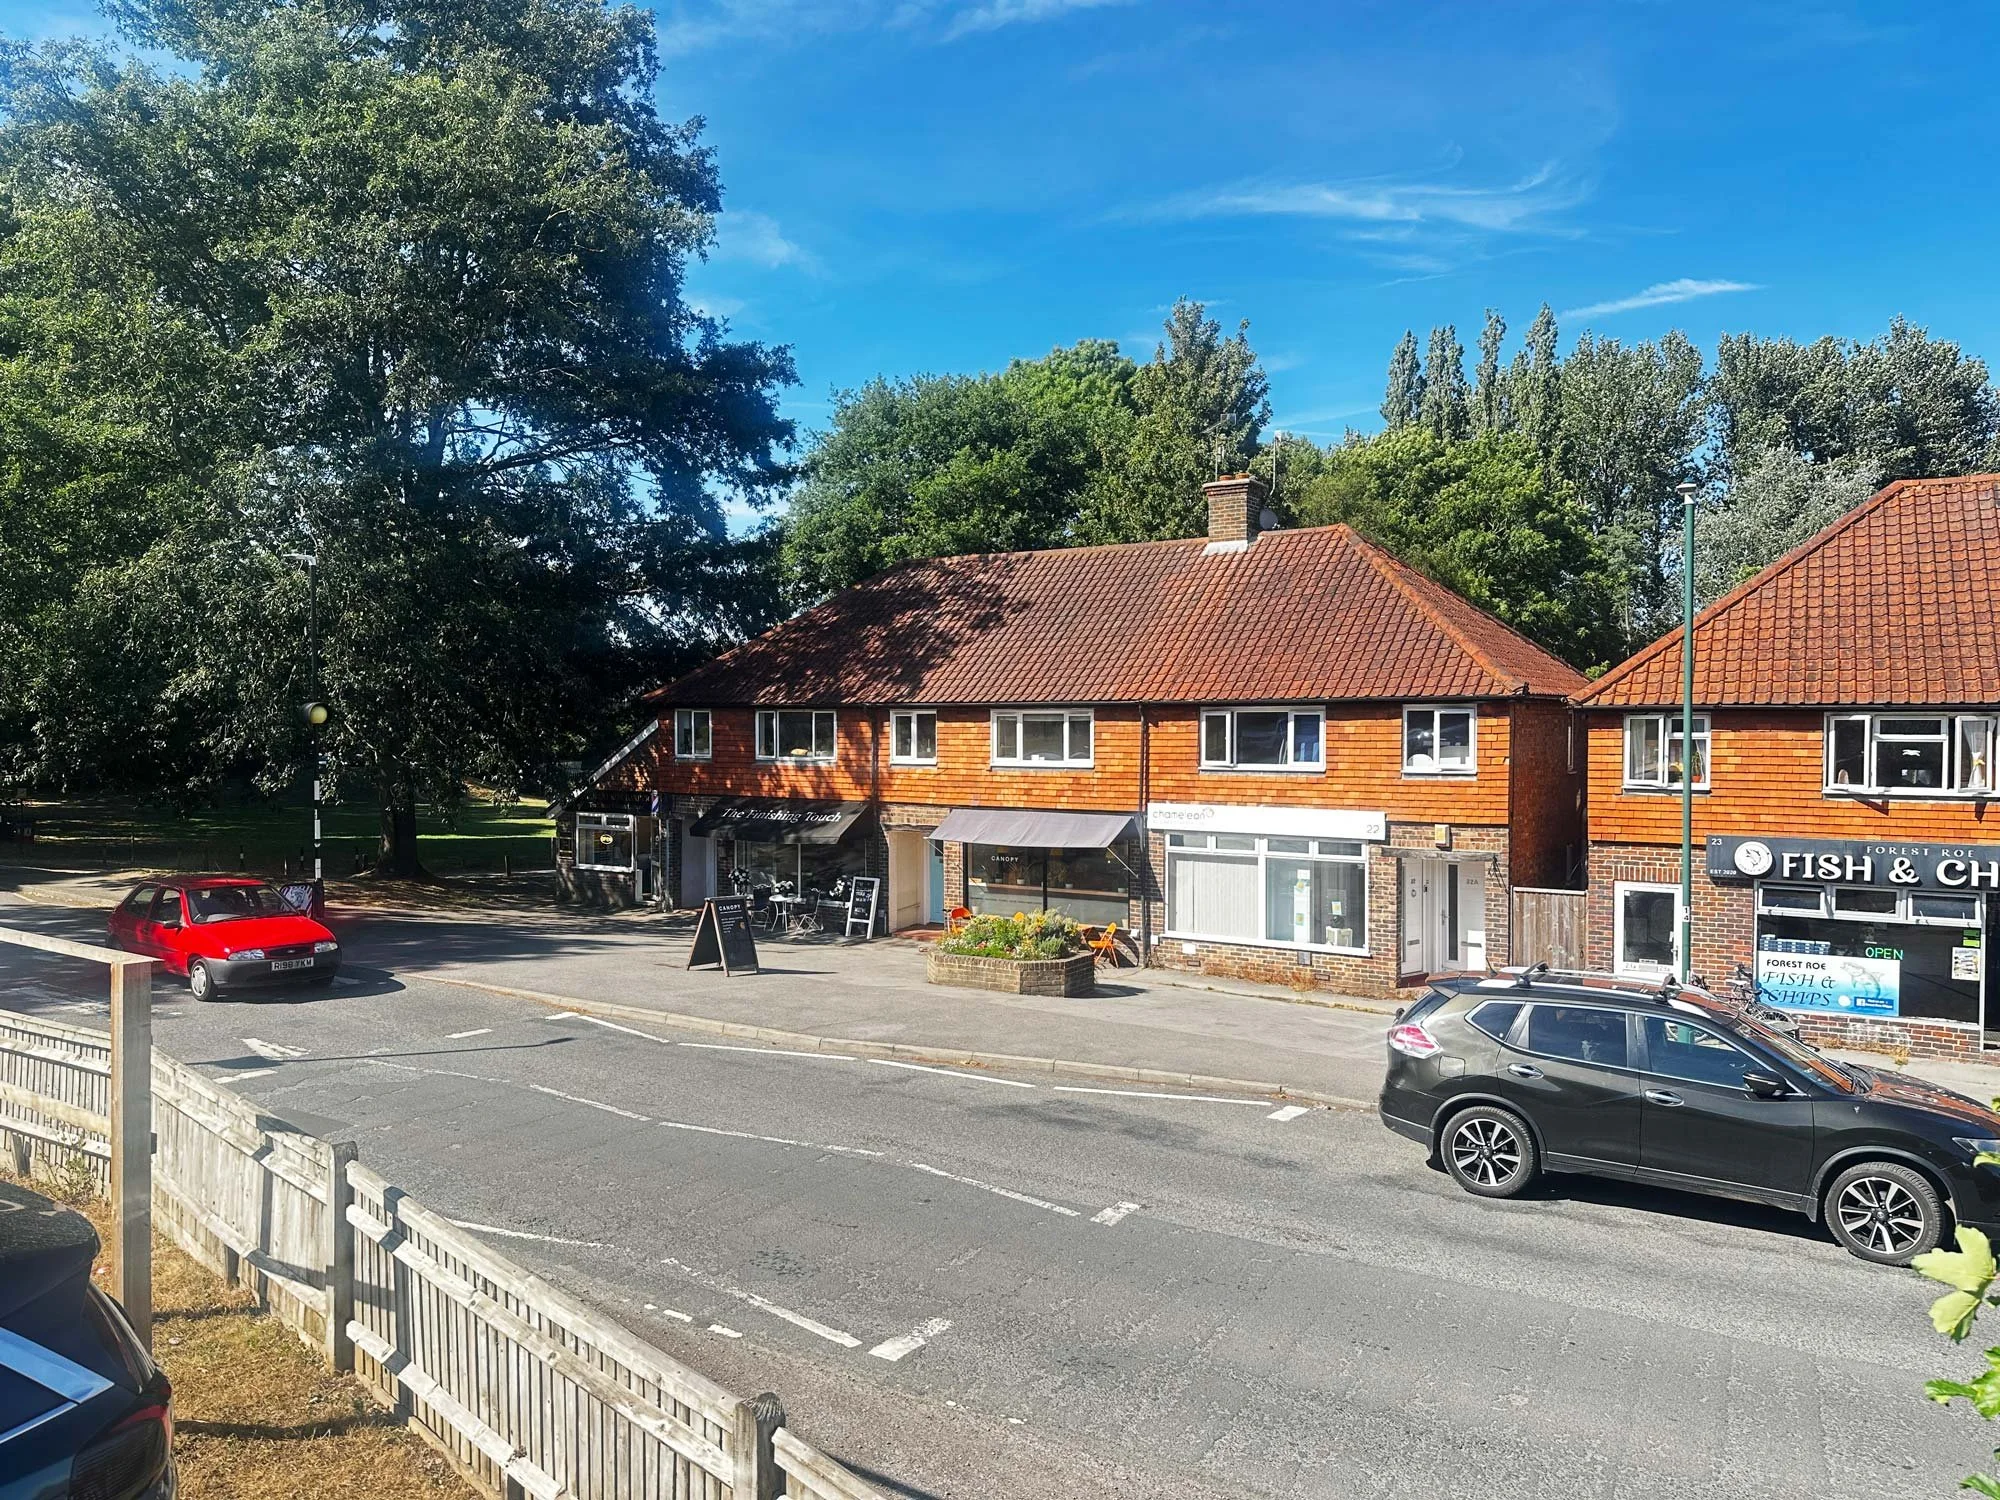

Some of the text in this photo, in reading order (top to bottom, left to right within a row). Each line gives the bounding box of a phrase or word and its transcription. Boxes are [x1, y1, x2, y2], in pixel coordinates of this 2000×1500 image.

[721, 808, 842, 824] The Finishing Touch
[1366, 824, 1380, 834] 22
[1711, 838, 1722, 846] 23
[1866, 846, 1976, 858] FOREST ROE
[1780, 852, 1872, 882] FISH
[1888, 857, 1920, 884] &
[718, 904, 741, 912] CANOPY
[1864, 946, 1904, 960] OPEN
[1766, 959, 1827, 970] FOREST ROE
[1763, 971, 1837, 989] FISH &
